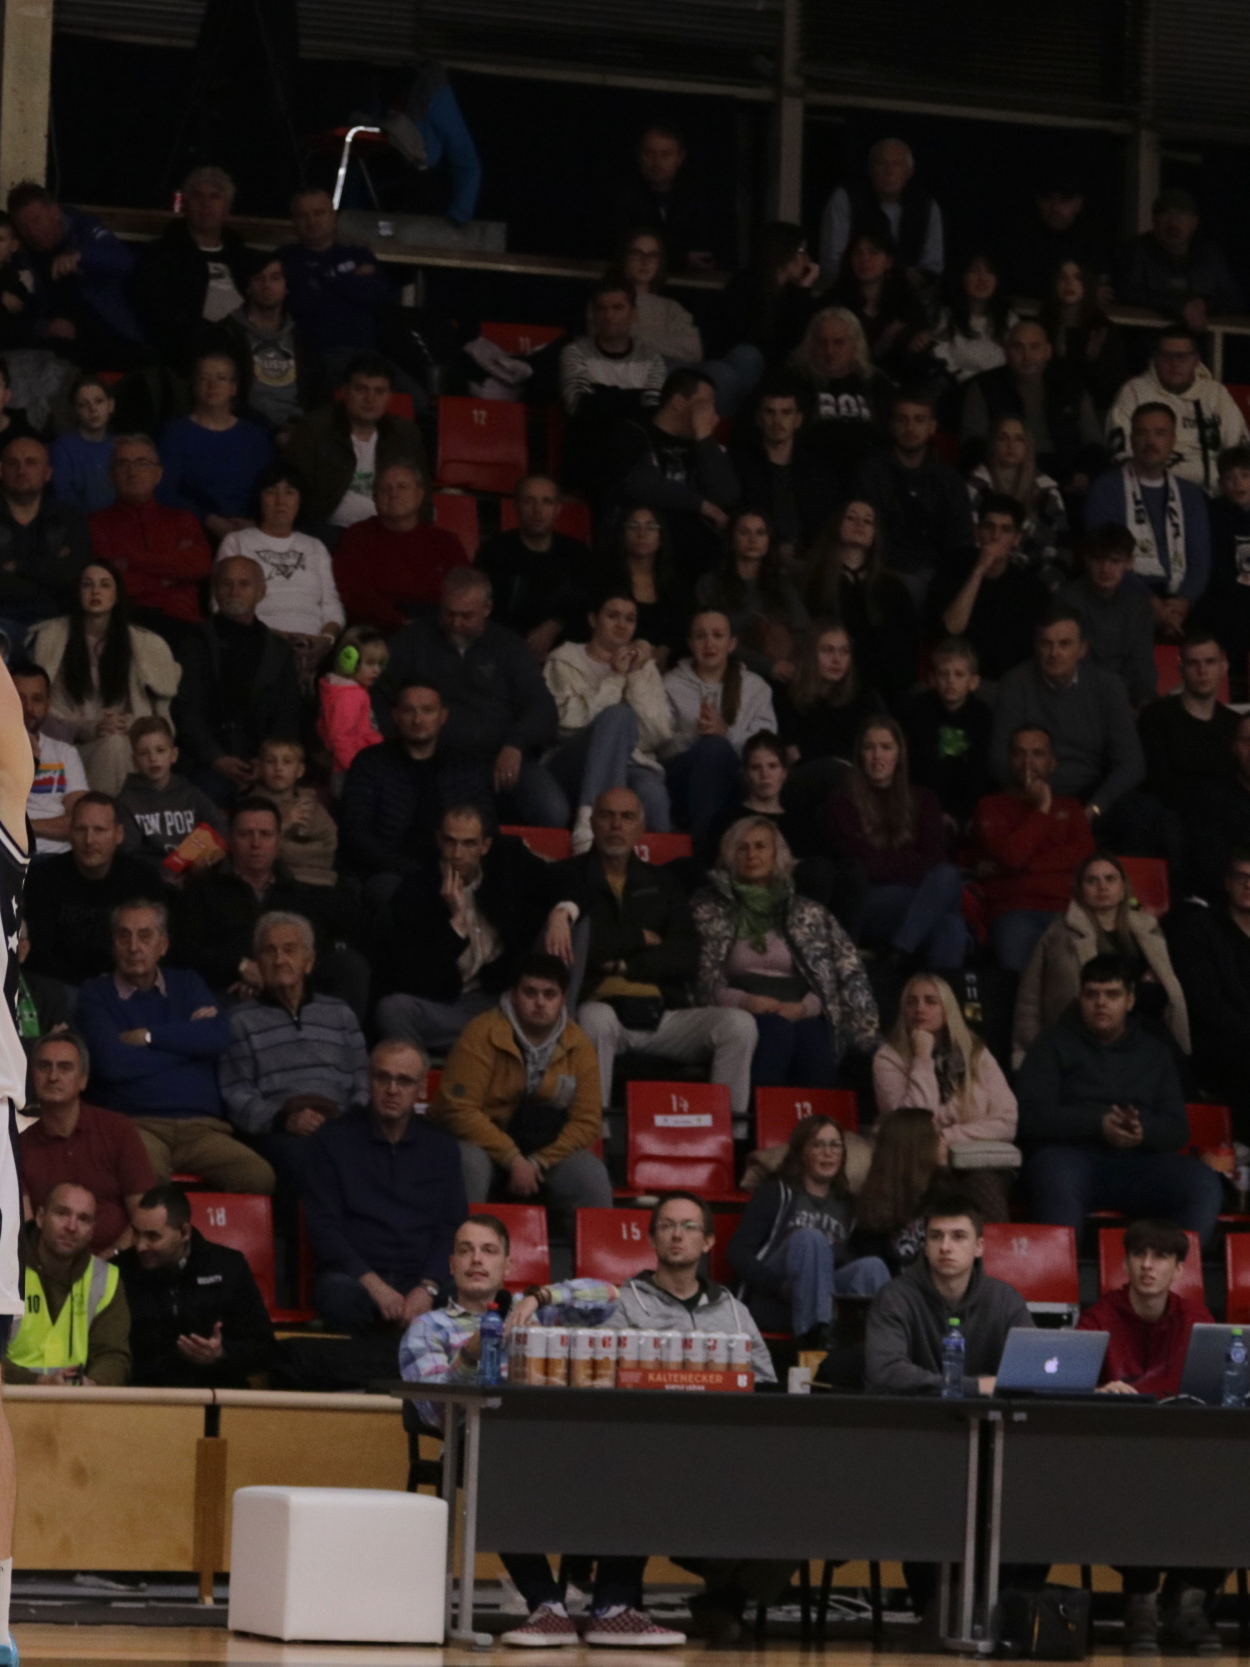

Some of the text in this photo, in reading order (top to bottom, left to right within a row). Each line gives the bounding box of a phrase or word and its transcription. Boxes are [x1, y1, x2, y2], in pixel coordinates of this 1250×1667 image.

[794, 1101, 812, 1121] 13
[206, 1207, 227, 1227] 18
[621, 1221, 642, 1241] 15
[27, 1294, 41, 1314] 10
[647, 1371, 724, 1384] KALTENECKER
